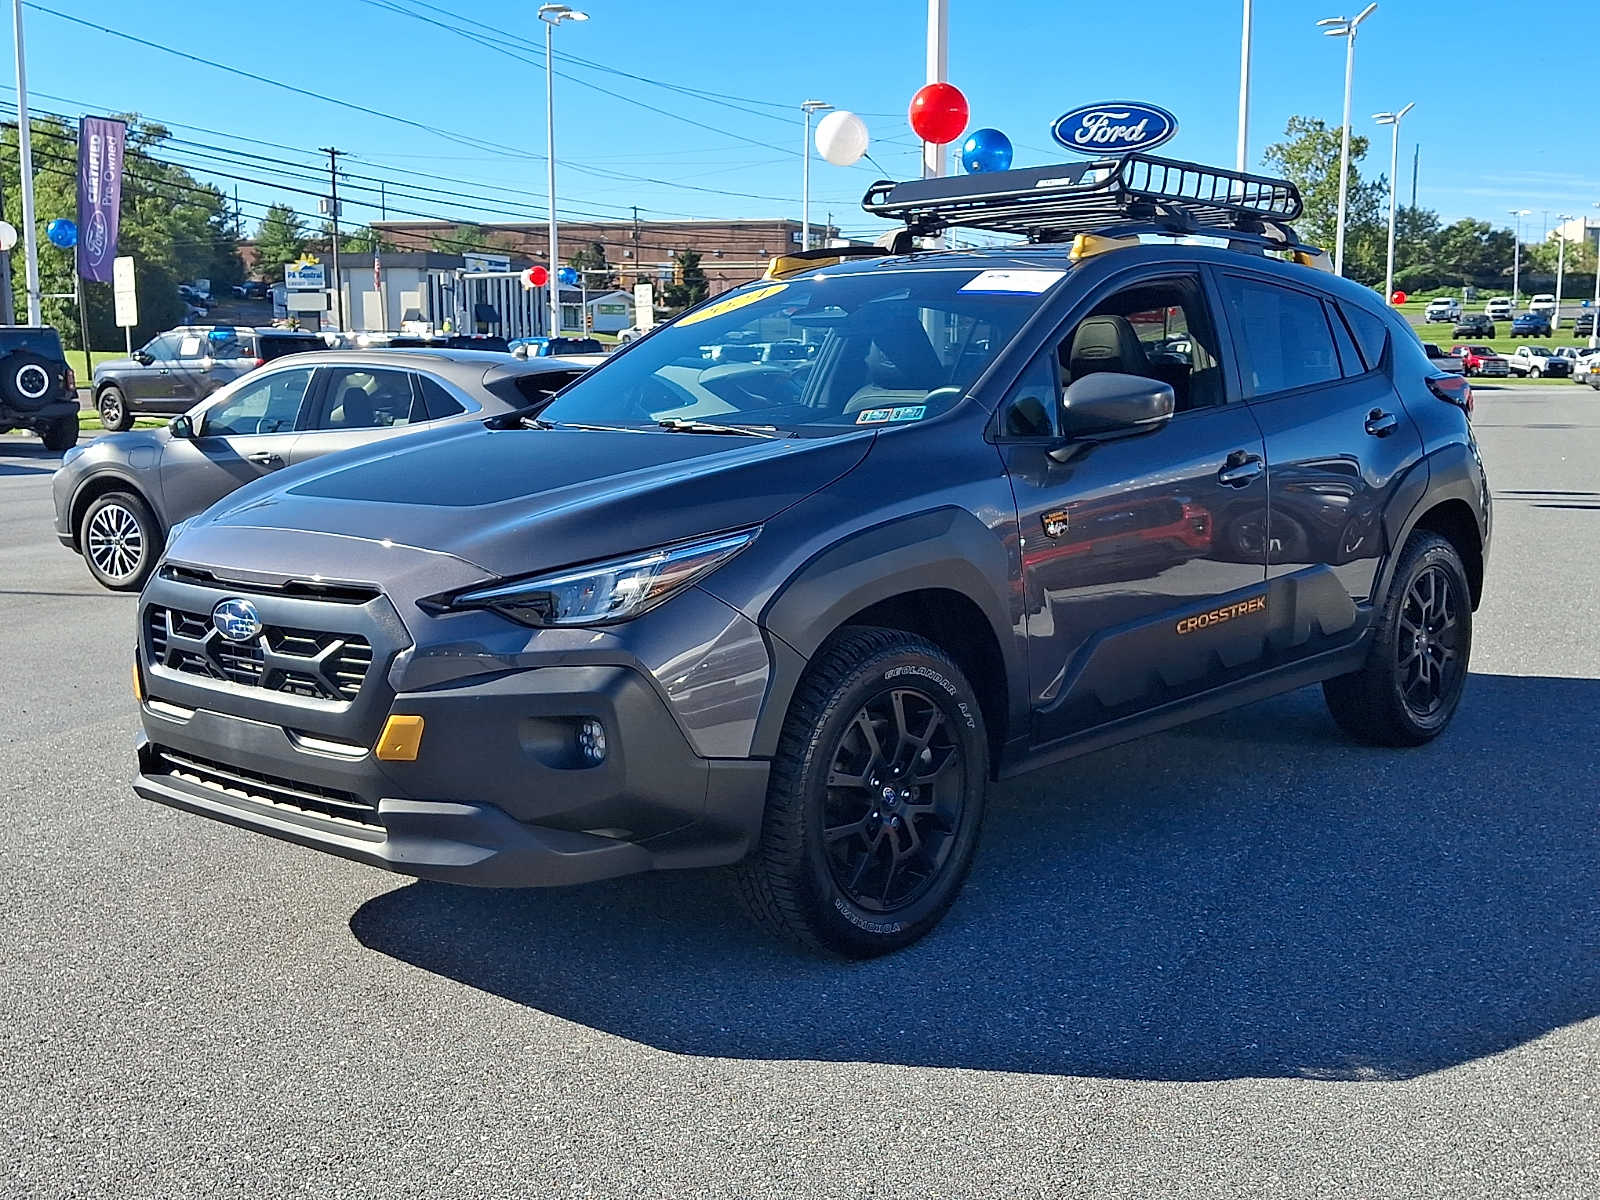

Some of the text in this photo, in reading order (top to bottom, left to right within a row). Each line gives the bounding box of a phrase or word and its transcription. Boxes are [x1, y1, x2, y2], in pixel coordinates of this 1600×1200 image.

[1074, 112, 1149, 144] Ford
[88, 135, 101, 204] CERTIFIED
[102, 135, 117, 207] Pre-Owned
[88, 222, 104, 256] Ford
[1176, 595, 1266, 635] CROSSTREK
[884, 665, 975, 729] GEOLANDAR A/T
